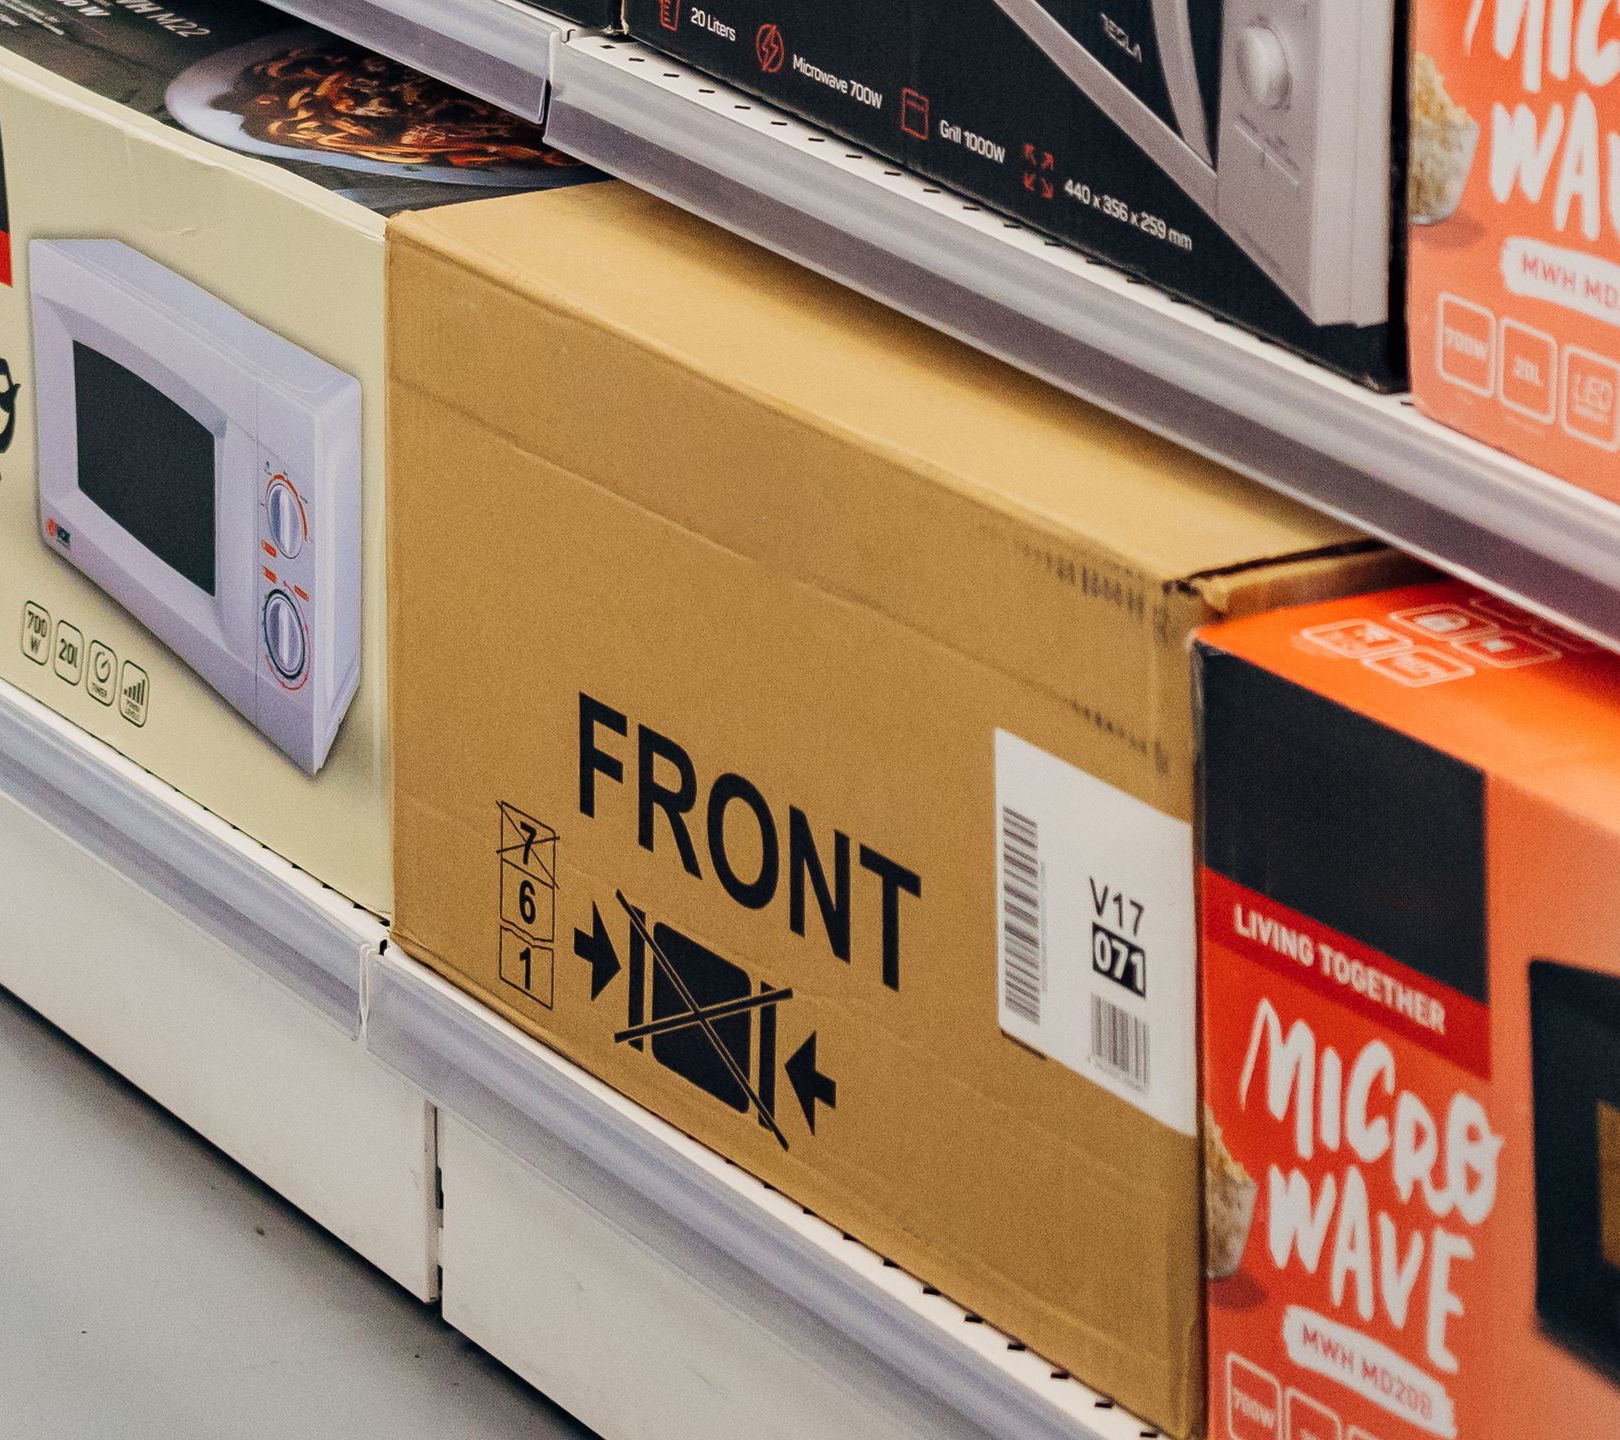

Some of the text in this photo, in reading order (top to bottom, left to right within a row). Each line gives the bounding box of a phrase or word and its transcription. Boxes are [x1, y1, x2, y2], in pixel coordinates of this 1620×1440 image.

[146, 11, 211, 38] M22
[689, 6, 737, 43] 20 Liters
[792, 52, 884, 110] Microwave 700W
[939, 119, 1007, 166] Grill 1000W
[1064, 177, 1092, 206] 440
[1102, 193, 1130, 225] 356
[1139, 208, 1167, 241] 259
[1167, 223, 1193, 253] mm
[1520, 250, 1578, 296] MWH
[26, 609, 49, 639] 700
[29, 637, 42, 655] W
[518, 819, 538, 866] 7
[578, 690, 923, 994] FRONT
[518, 879, 537, 926] 6
[1088, 874, 1146, 938] V17
[518, 946, 533, 991] 1
[1092, 930, 1146, 993] 071
[1233, 901, 1447, 1036] LIVING TOGETHER
[1238, 996, 1506, 1227] MICRO
[1267, 1163, 1476, 1374] WAVE
[1301, 1322, 1357, 1376] MWH
